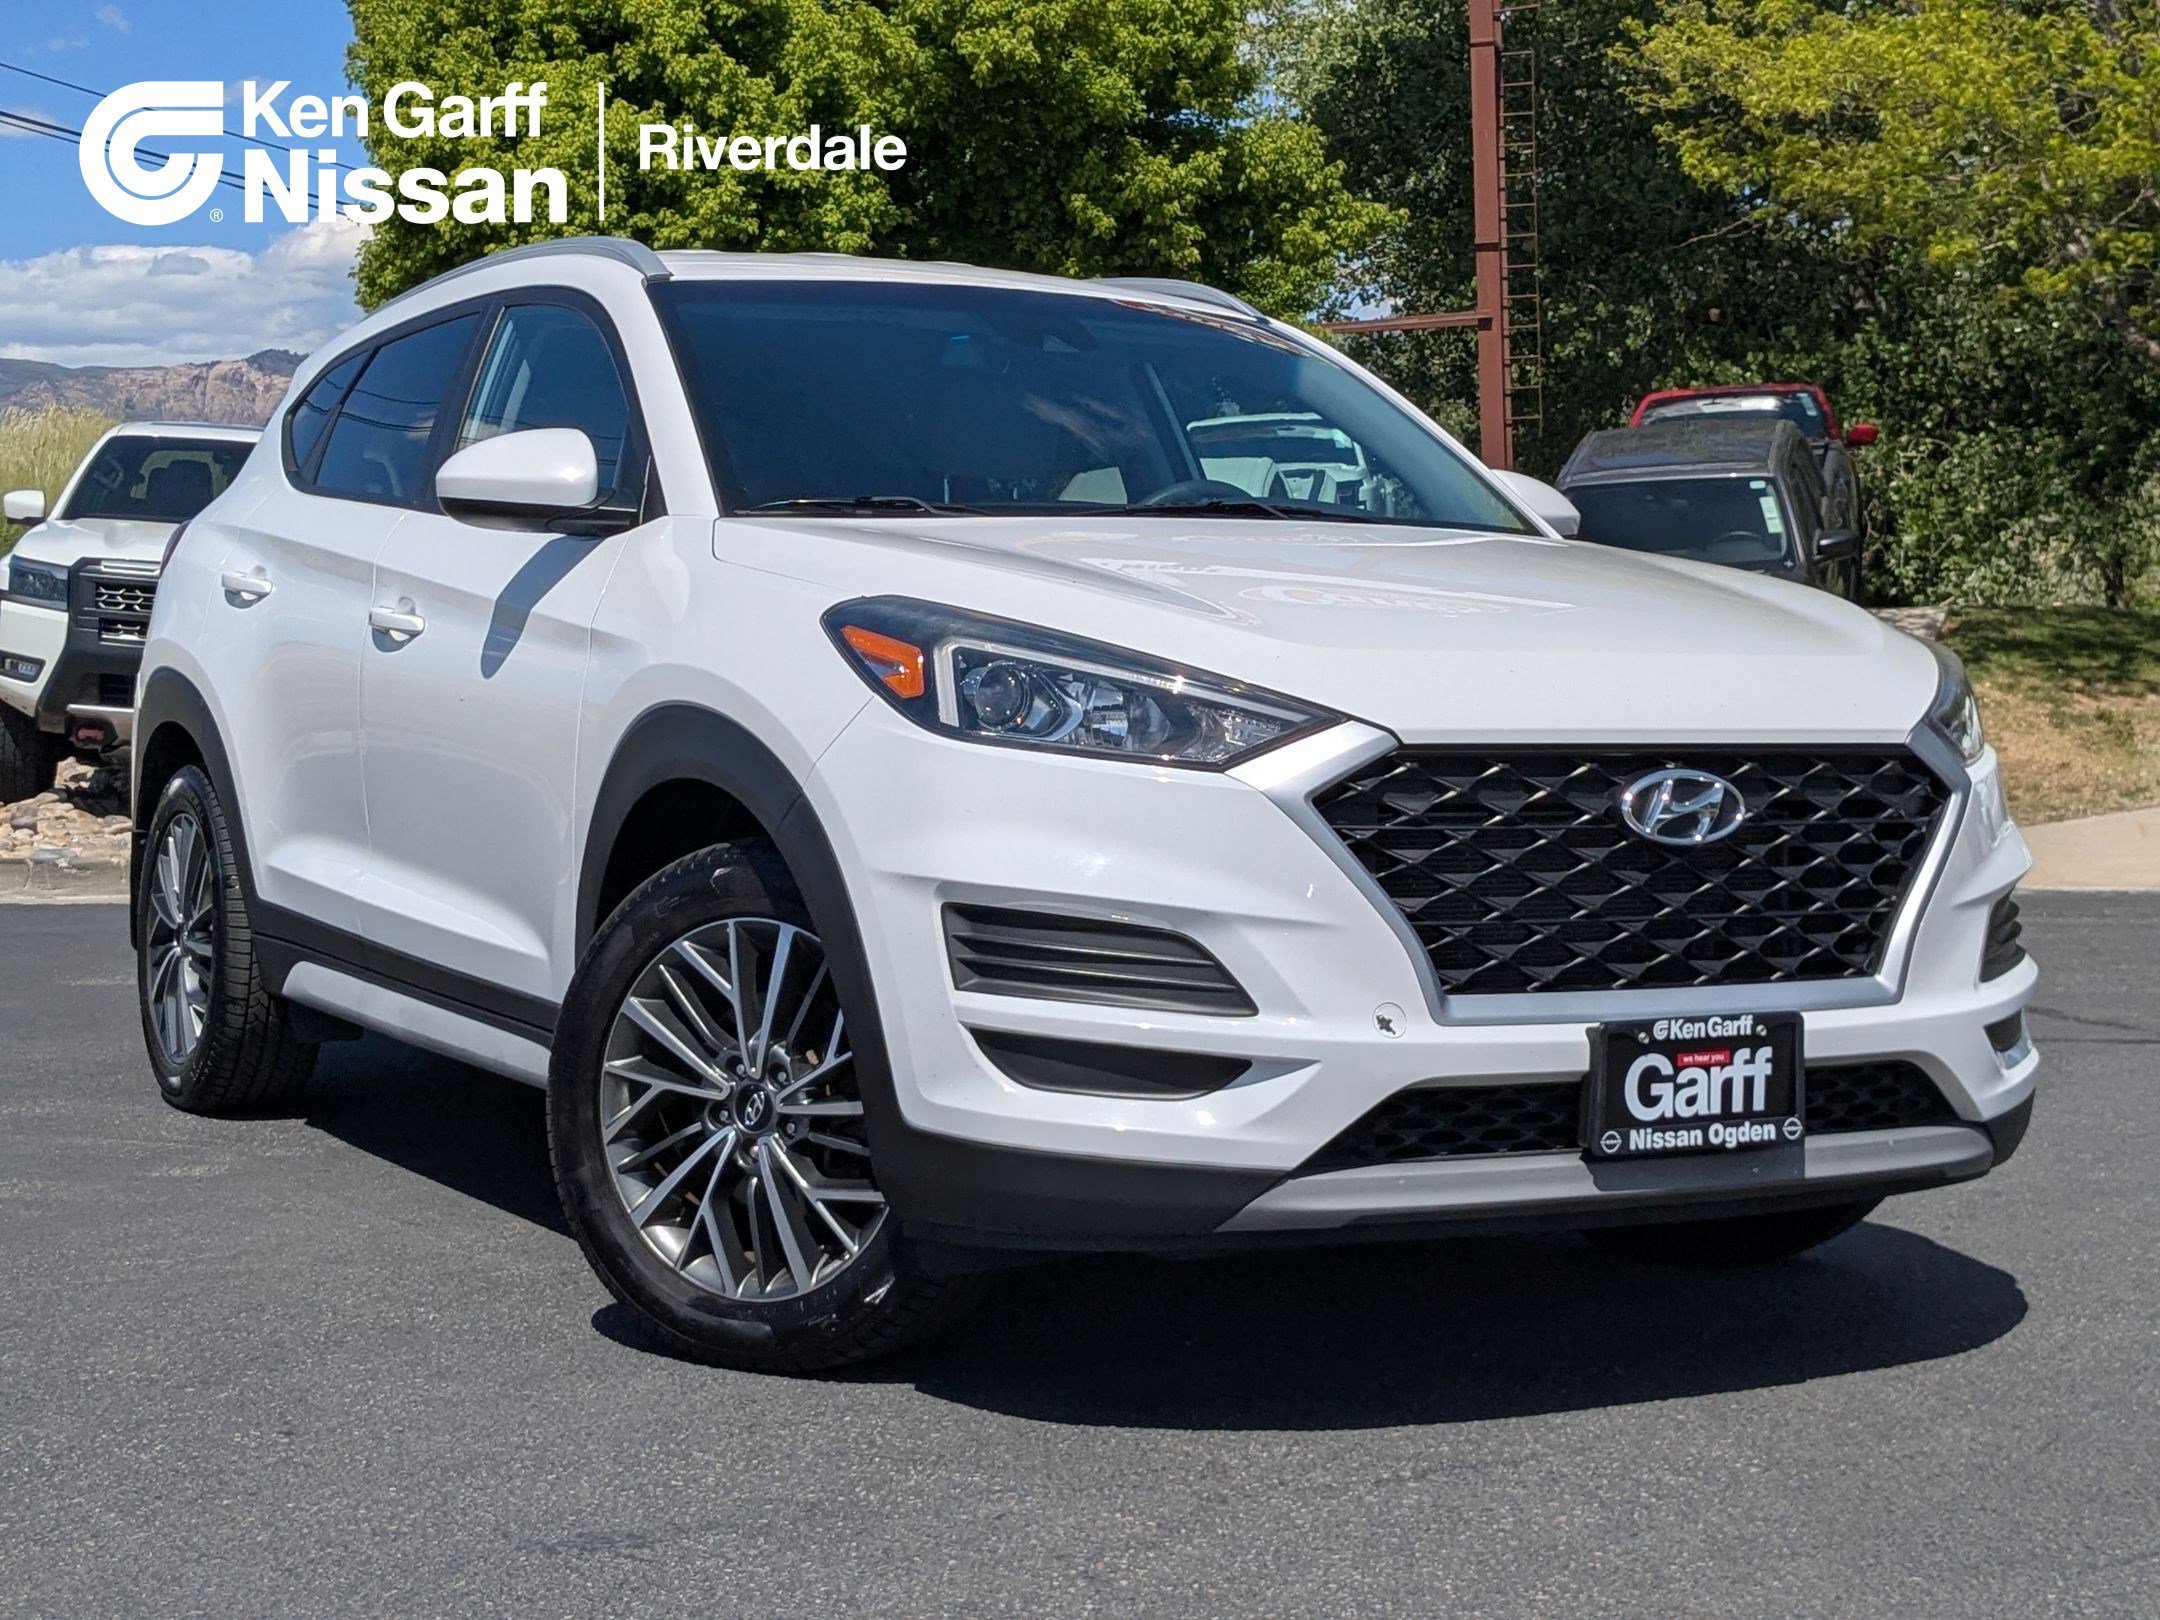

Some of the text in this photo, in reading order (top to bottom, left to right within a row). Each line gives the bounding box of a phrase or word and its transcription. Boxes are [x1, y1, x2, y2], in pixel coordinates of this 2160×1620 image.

[1669, 1014, 1754, 1040] Ken Garff
[1624, 1046, 1773, 1121] Garff
[1629, 1120, 1776, 1150] Nissan Ogden
